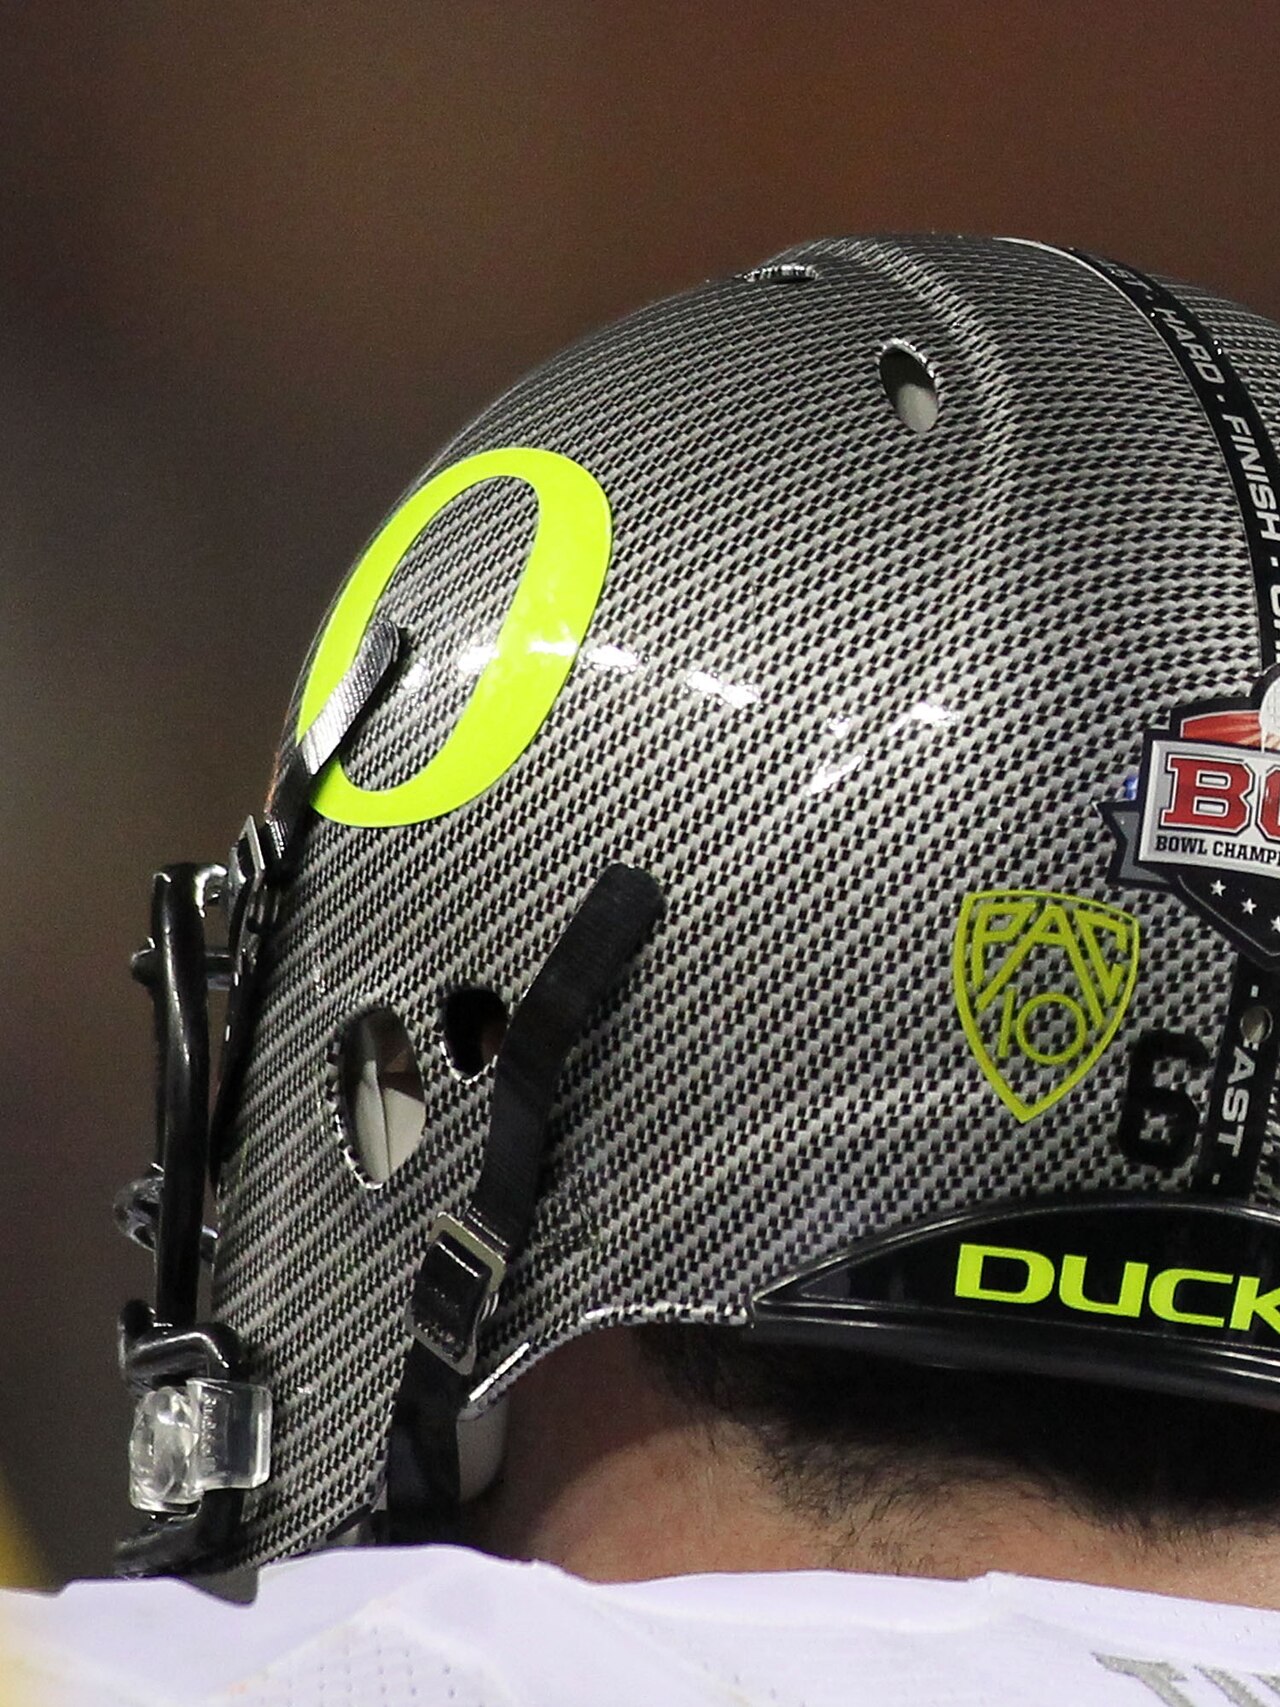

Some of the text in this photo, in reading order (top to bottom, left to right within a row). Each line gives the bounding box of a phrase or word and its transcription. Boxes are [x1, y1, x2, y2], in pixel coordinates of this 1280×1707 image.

[1152, 306, 1226, 384] HARD
[296, 447, 613, 828] O
[1155, 834, 1208, 855] BOWL
[970, 902, 1130, 1029] PAC
[998, 986, 1088, 1066] 10
